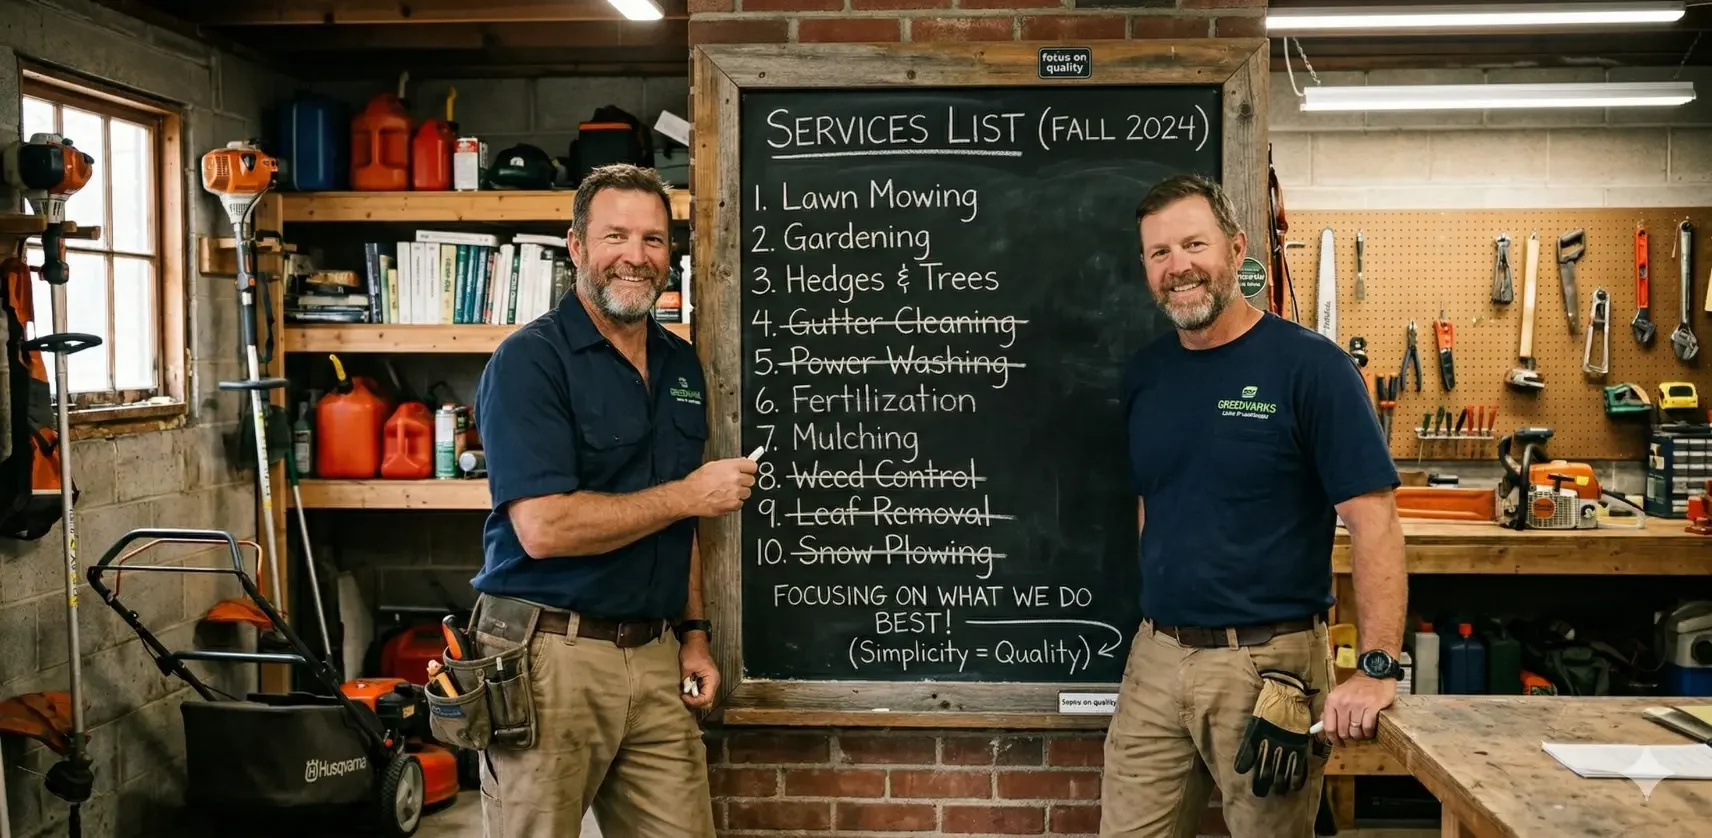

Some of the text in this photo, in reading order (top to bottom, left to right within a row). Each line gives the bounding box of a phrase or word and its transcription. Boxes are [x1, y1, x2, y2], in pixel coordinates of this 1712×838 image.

[1046, 62, 1083, 74] quality
[766, 104, 1210, 152] SERVICES LIST (FALL 2024)
[754, 178, 979, 223] 1. Lawn Mowing
[751, 222, 931, 261] 2. Gardening
[751, 262, 1000, 303] 3. Hedges & Trees
[751, 306, 1018, 348] 4. Gutter Cleaning
[754, 345, 1009, 389] 5. Power Washing
[755, 383, 977, 414] 6. Fertilization
[756, 421, 919, 464] 7. Mulching
[758, 457, 977, 491] 8. Weed Control
[758, 494, 992, 528] 9. Leaf Removal
[757, 534, 993, 580] 10. Snow Plowing
[774, 584, 1093, 608] FOCUSING ON WHAT WE DO
[875, 609, 952, 635] BEST!
[848, 635, 969, 673] (Simplicity
[995, 634, 1091, 675] Quality)
